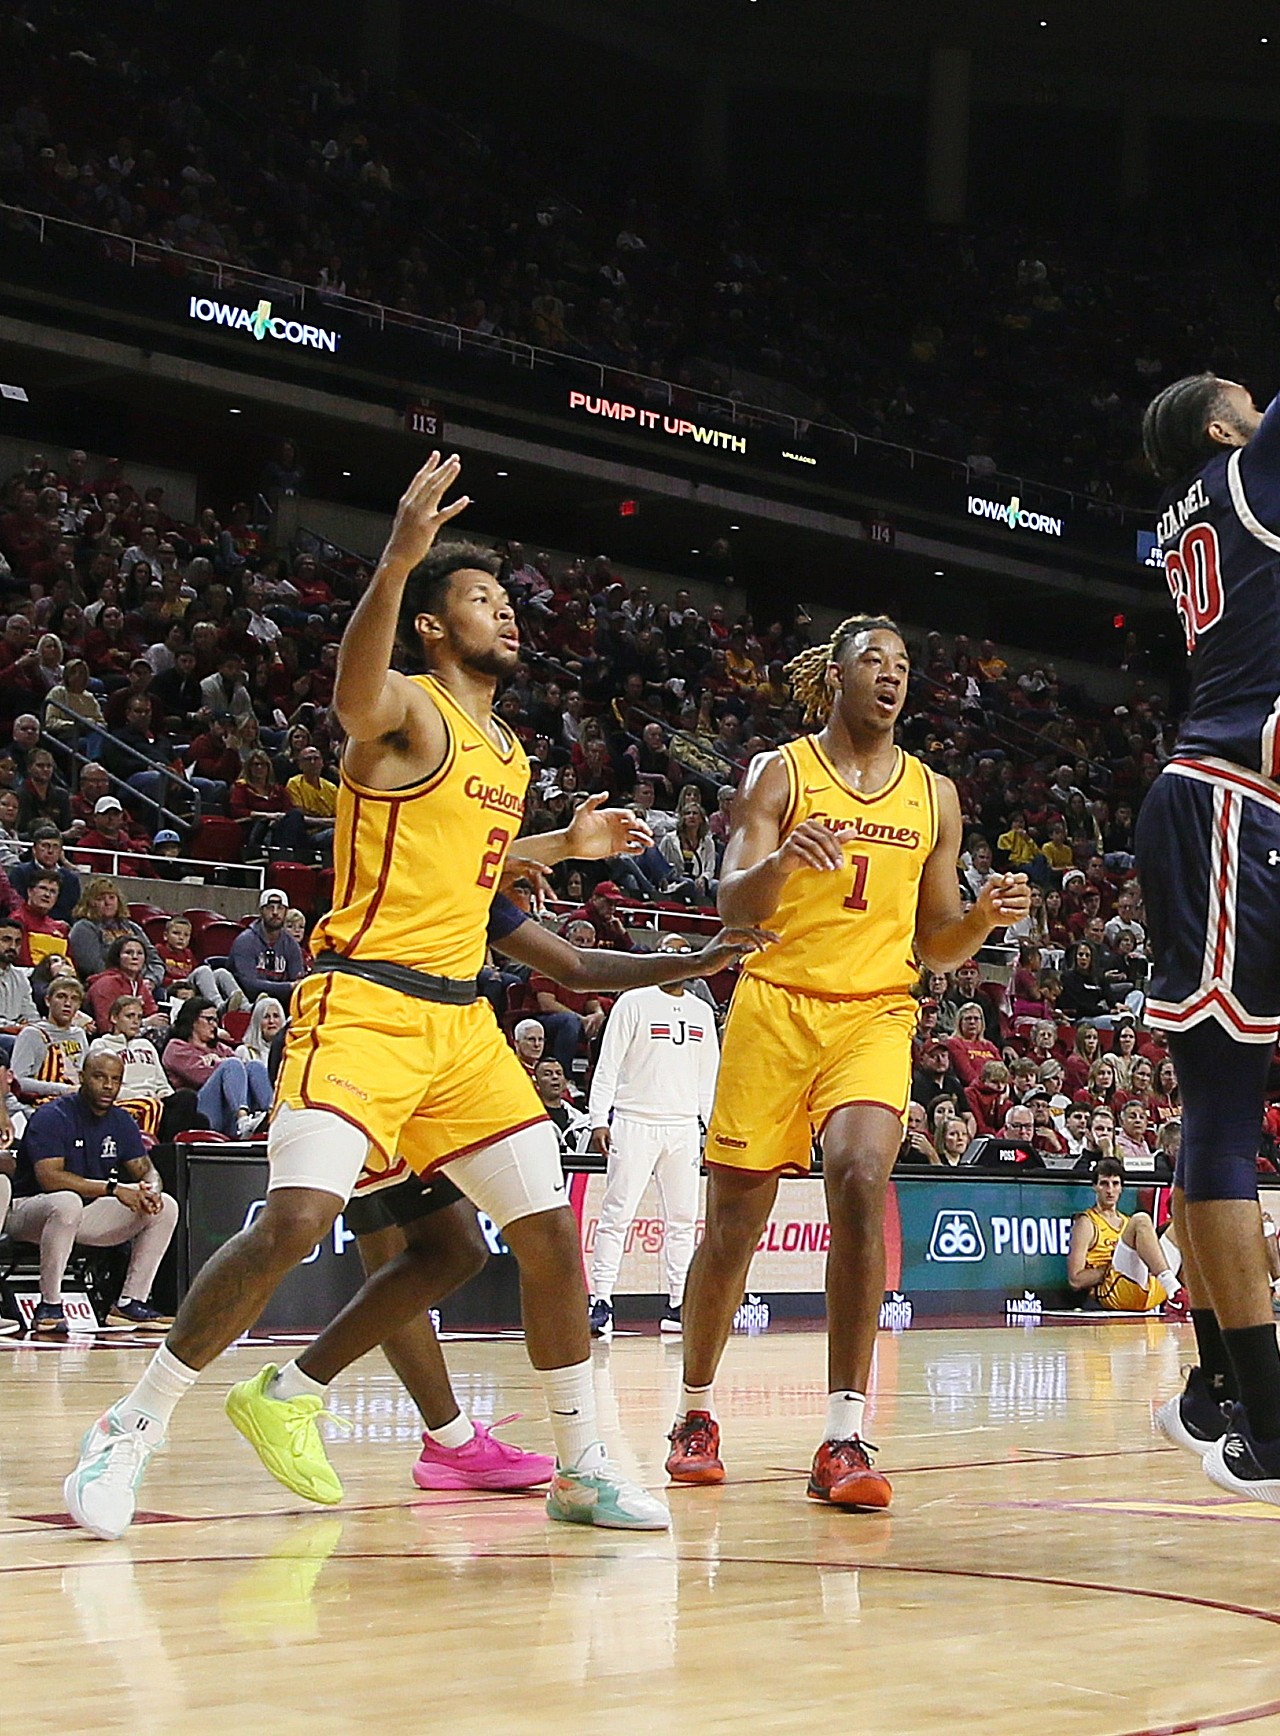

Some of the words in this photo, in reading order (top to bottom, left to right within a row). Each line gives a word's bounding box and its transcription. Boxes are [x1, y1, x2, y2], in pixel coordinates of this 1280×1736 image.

[190, 297, 253, 332] IOWA
[269, 317, 336, 353] CORN
[412, 413, 437, 435] 113
[570, 391, 635, 421] PUMP
[640, 410, 660, 429] IT
[968, 496, 1008, 522] IOWA
[1018, 510, 1061, 536] CORN
[1164, 522, 1225, 656] 30
[464, 774, 526, 819] Cyclon
[476, 826, 509, 889] 2
[843, 855, 869, 911] 1
[672, 1020, 686, 1046] J
[585, 1219, 665, 1253] LT'S
[991, 1217, 1072, 1255] PIONE
[1006, 1299, 1042, 1313] LANDUS
